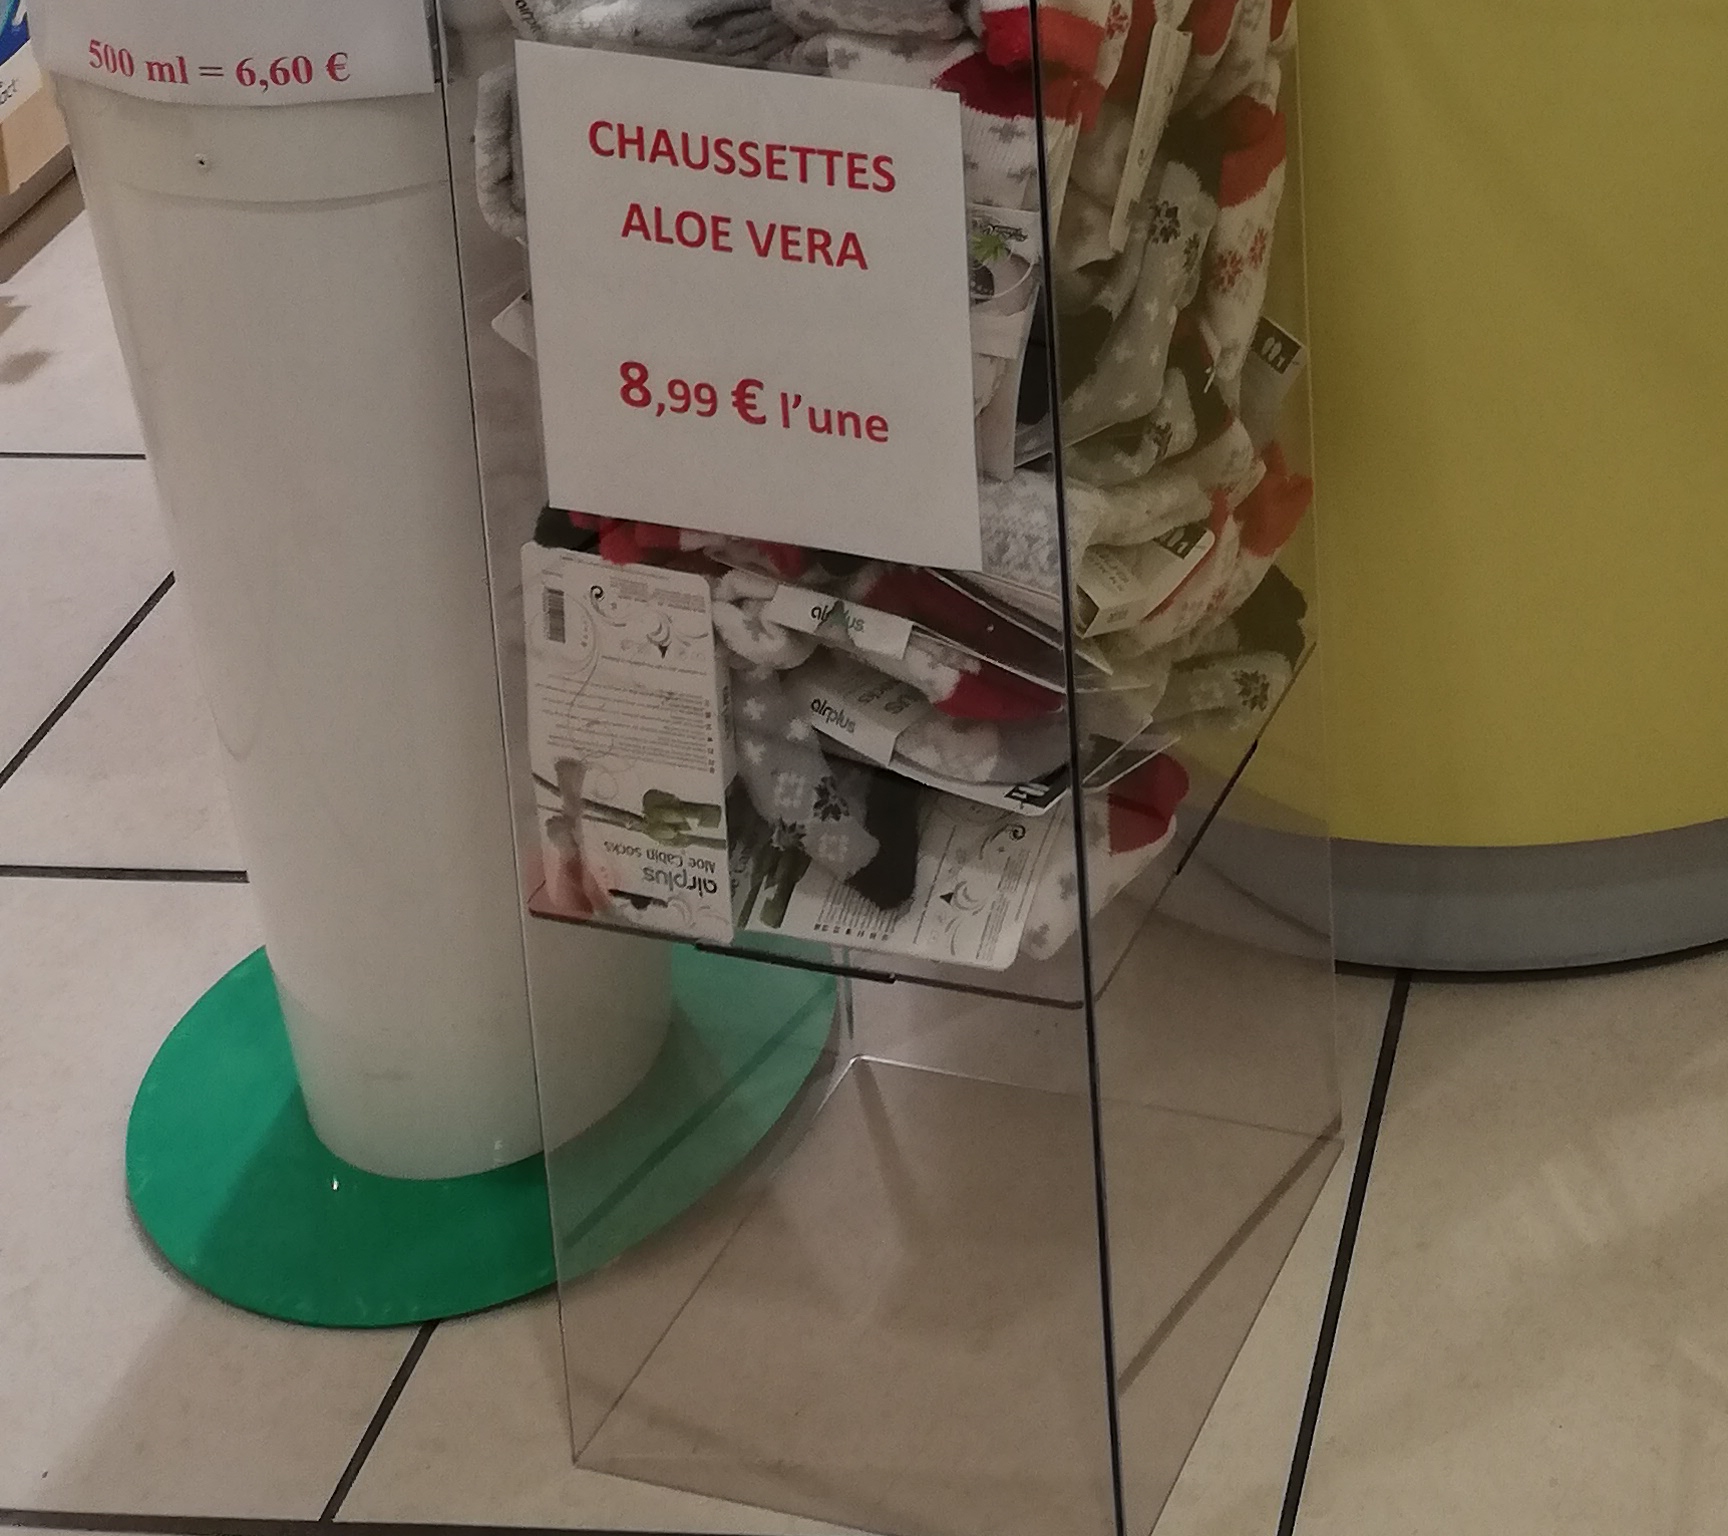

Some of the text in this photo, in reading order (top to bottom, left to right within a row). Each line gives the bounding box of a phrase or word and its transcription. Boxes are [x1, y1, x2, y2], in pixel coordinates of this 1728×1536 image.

[88, 39, 134, 77] 500
[146, 56, 189, 84] ml
[236, 55, 312, 93] 6,60
[326, 52, 350, 82] €
[588, 120, 896, 193] CHAUSSETTES
[621, 203, 868, 270] ALOE VERA
[619, 361, 889, 443] 8,99 € l'une
